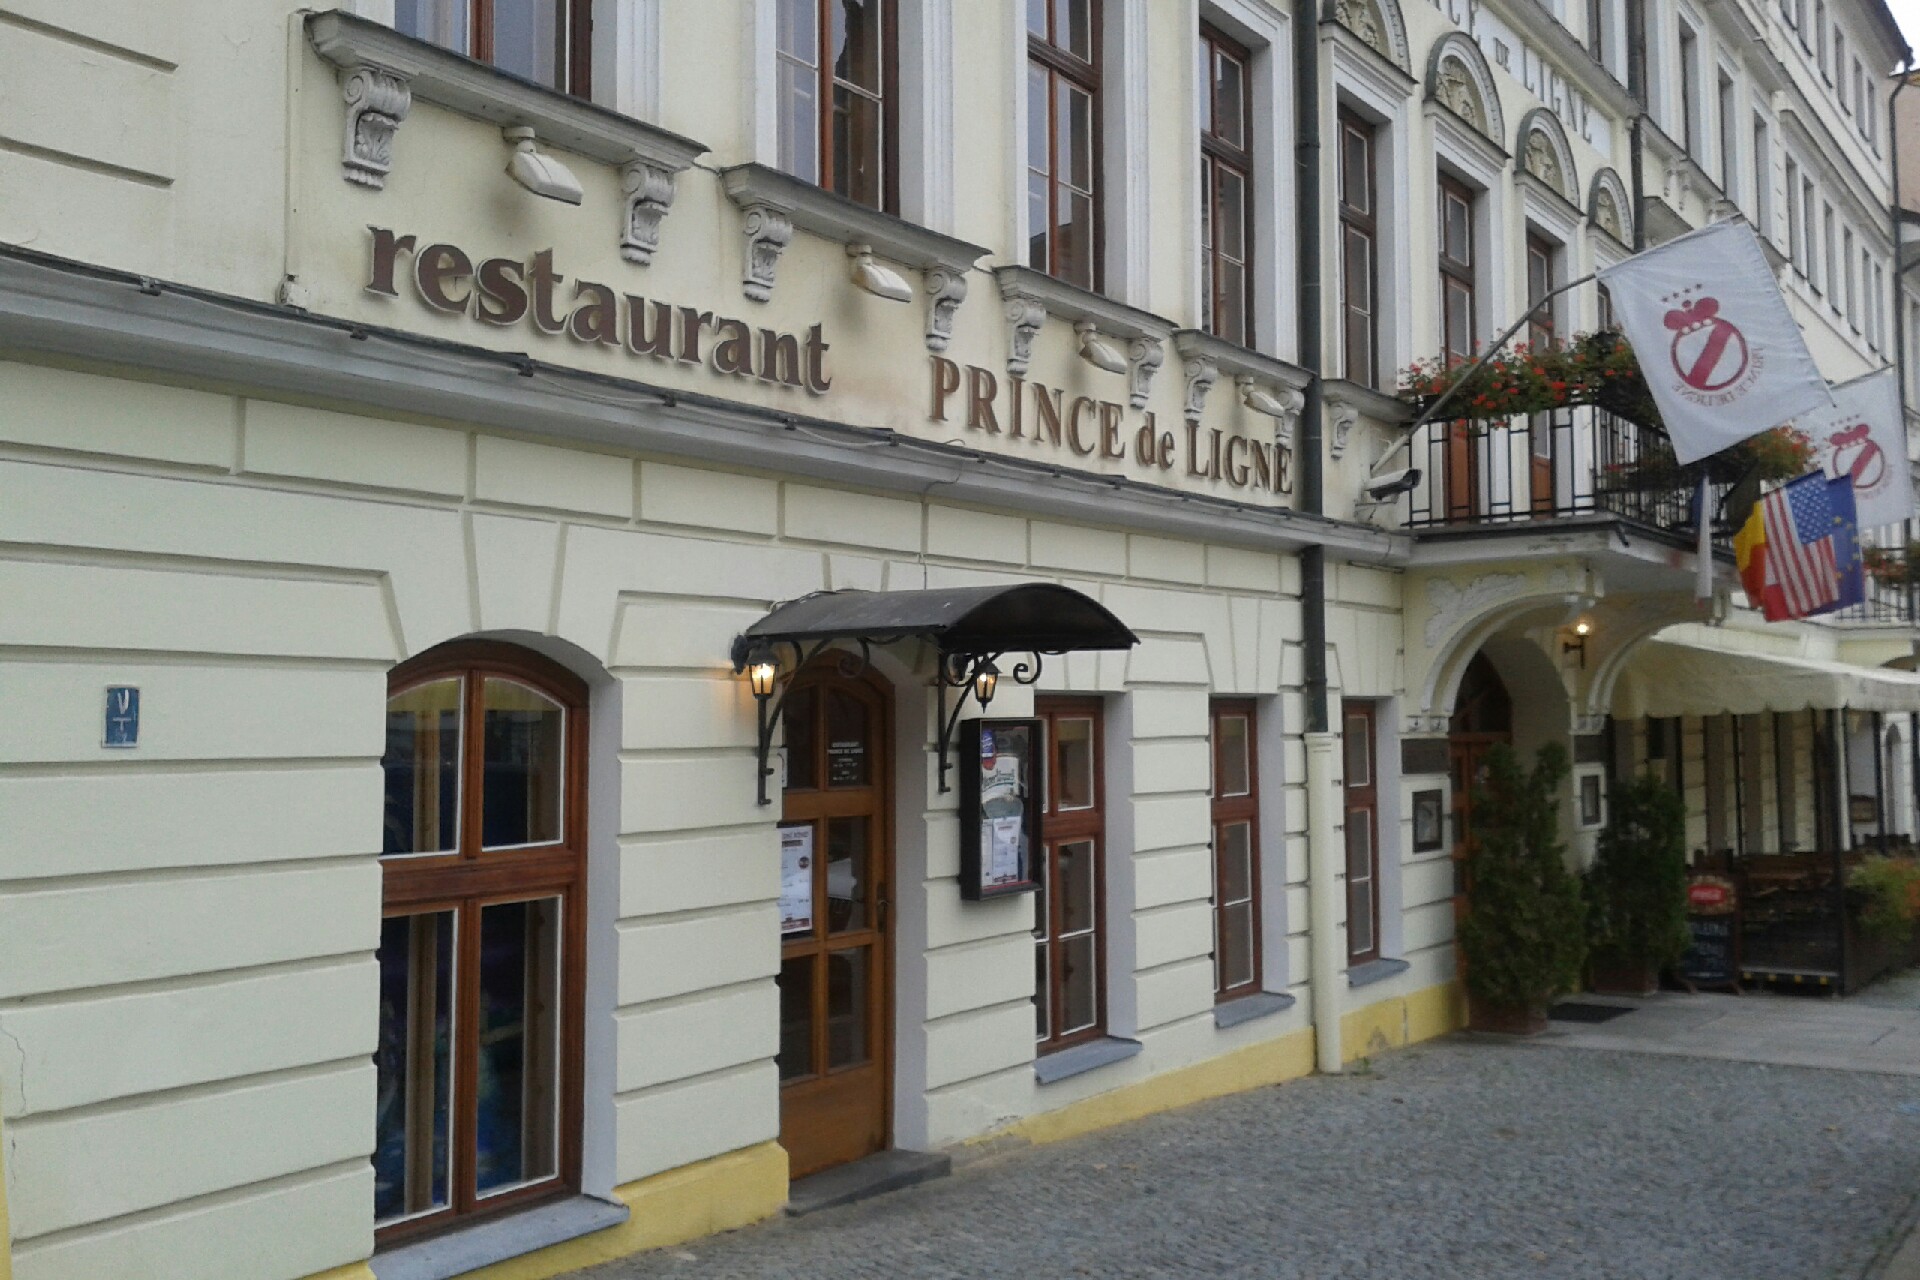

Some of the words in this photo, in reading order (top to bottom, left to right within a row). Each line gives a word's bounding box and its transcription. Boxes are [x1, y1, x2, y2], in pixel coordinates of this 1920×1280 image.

[365, 223, 833, 395] restaurant
[928, 354, 1127, 459] PRINCE
[1136, 411, 1176, 470] de
[1186, 418, 1293, 496] LIGNE
